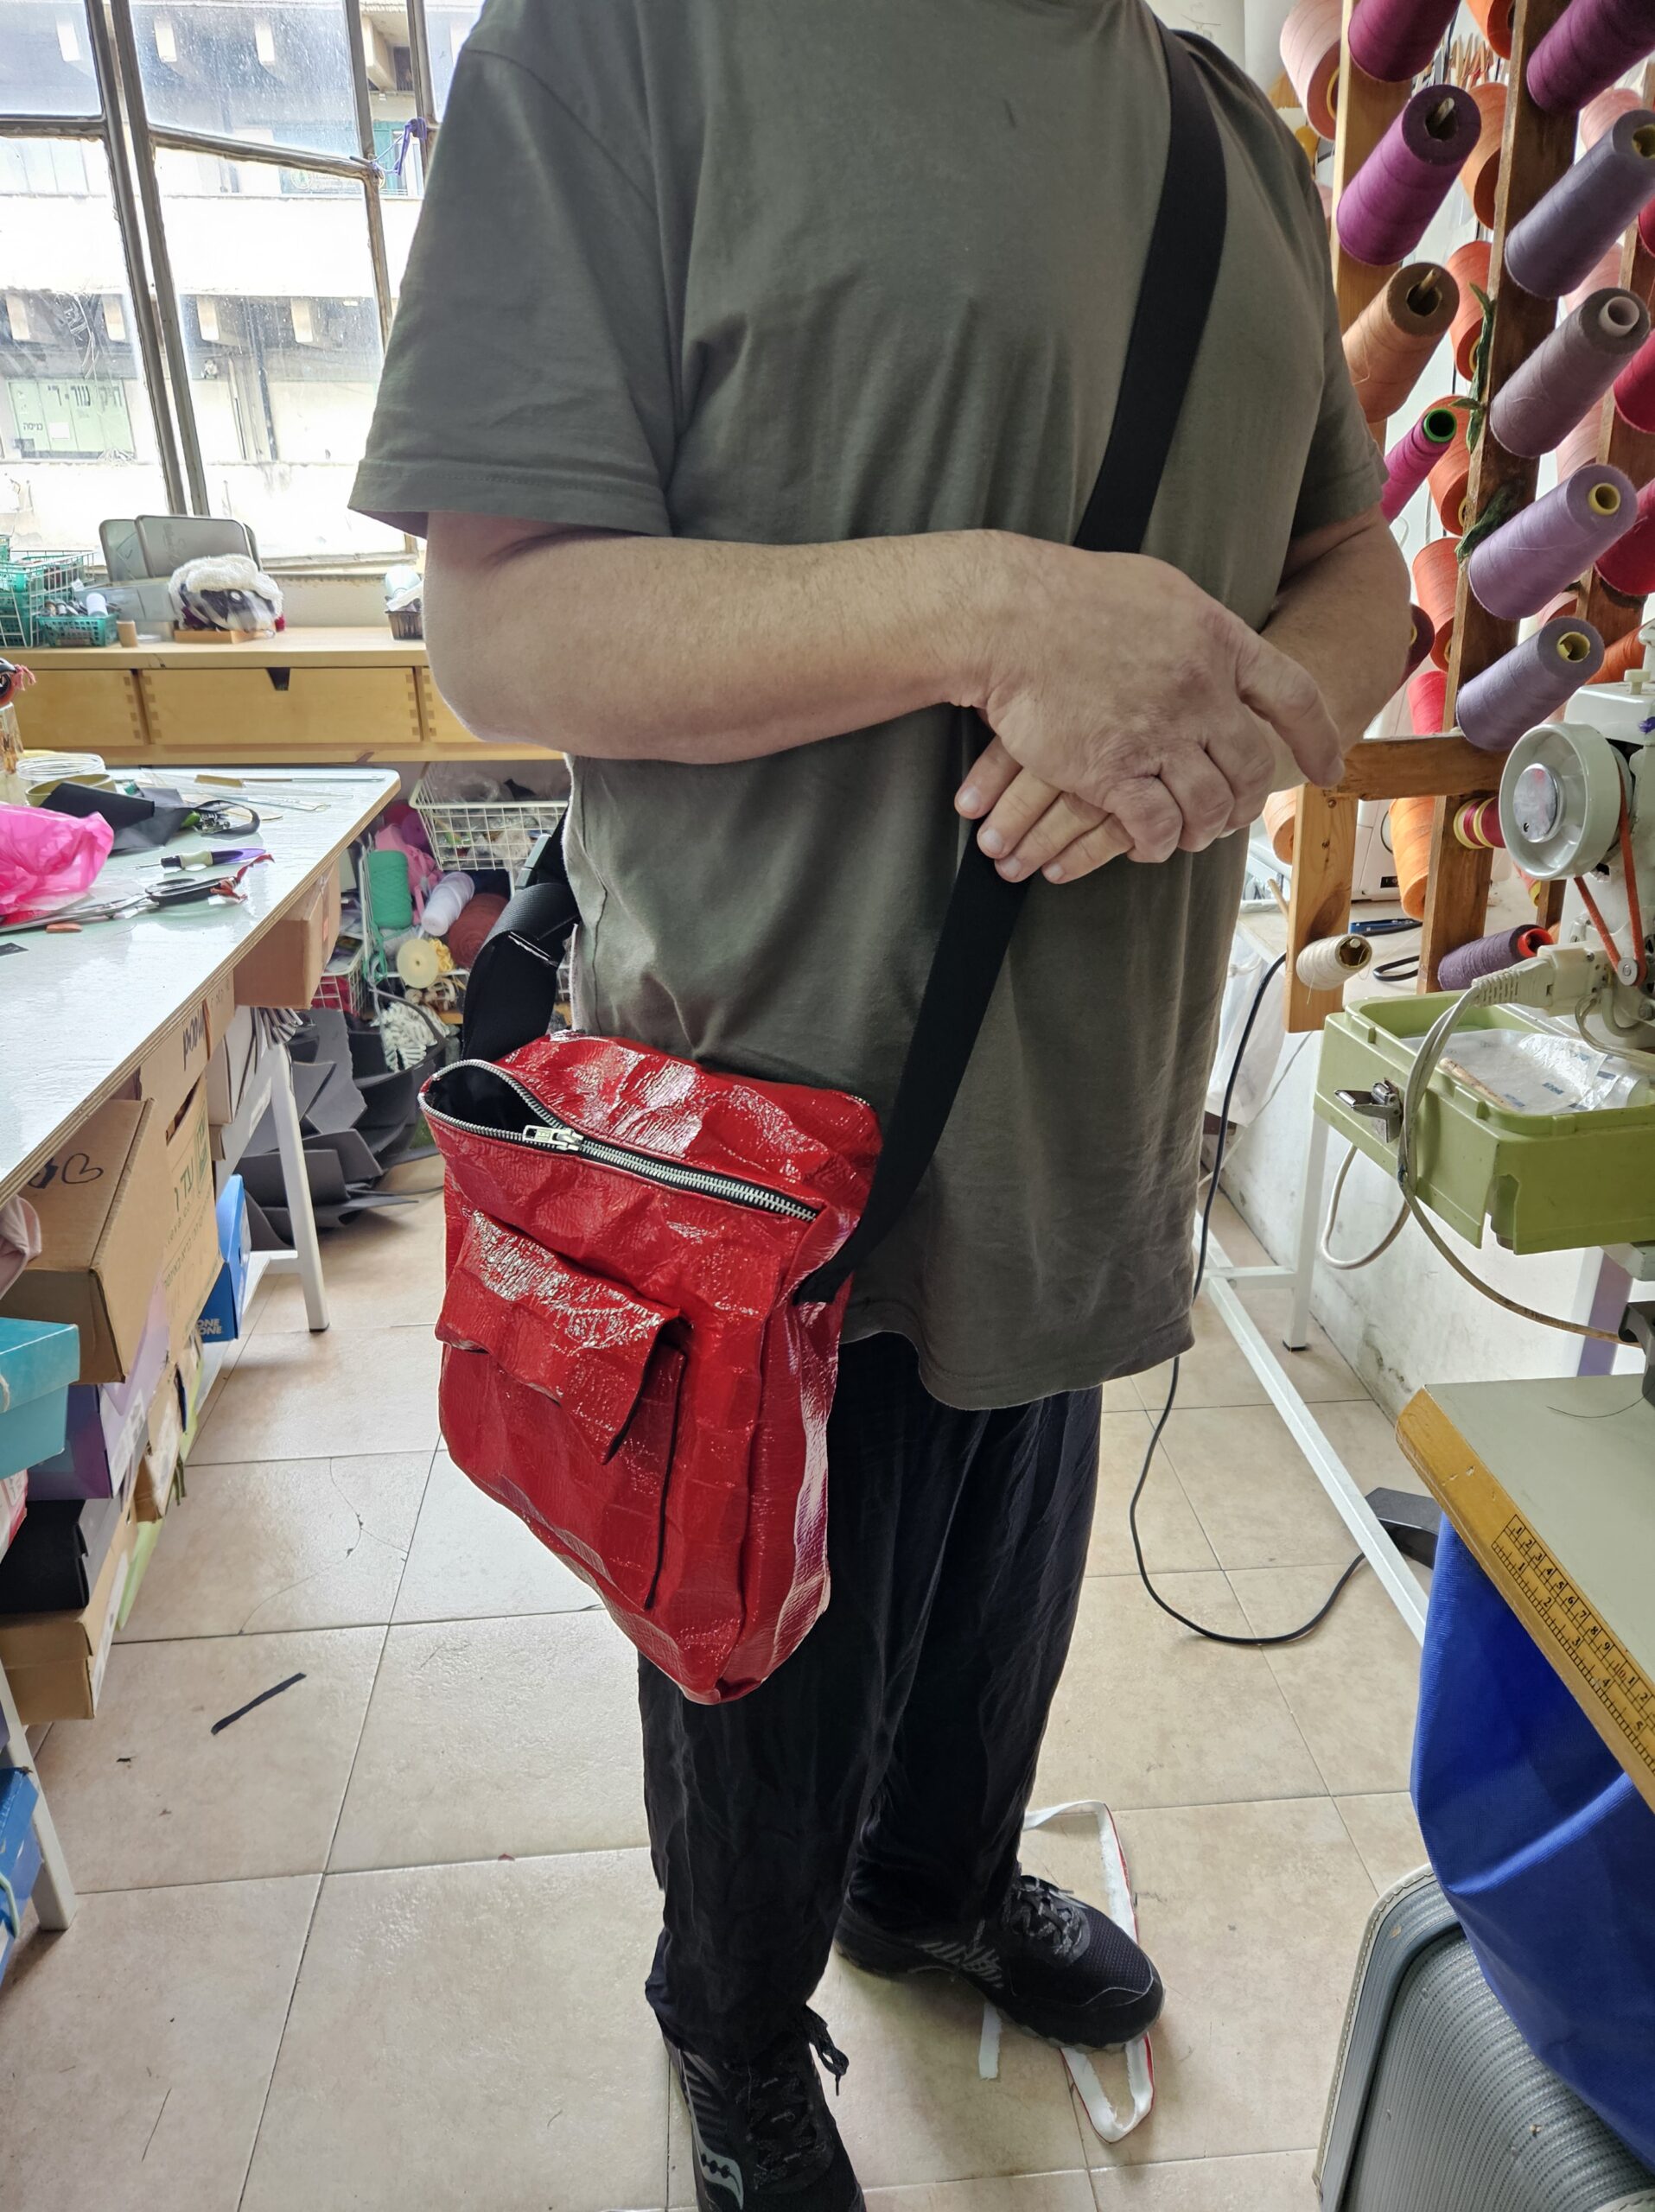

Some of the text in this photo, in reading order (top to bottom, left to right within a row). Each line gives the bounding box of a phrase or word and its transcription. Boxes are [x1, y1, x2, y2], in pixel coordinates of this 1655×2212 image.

[23, 422, 43, 431] כניסה
[174, 1156, 194, 1211] עדן
[196, 1319, 220, 1328] ONE
[199, 1326, 222, 1336] ONE
[1515, 1527, 1523, 1535] 1
[1525, 1539, 1533, 1548] 2
[1535, 1553, 1543, 1561] 3
[1545, 1567, 1553, 1576] 4
[1556, 1581, 1564, 1590] 5
[1568, 1596, 1575, 1605] 6
[1580, 1610, 1587, 1618] 7
[1590, 1625, 1599, 1636] 8
[1603, 1642, 1611, 1650] 9
[1613, 1663, 1626, 1678] 10
[1639, 1692, 1648, 1701] 2
[1518, 1562, 1644, 1732] 1 2 3 4 5
